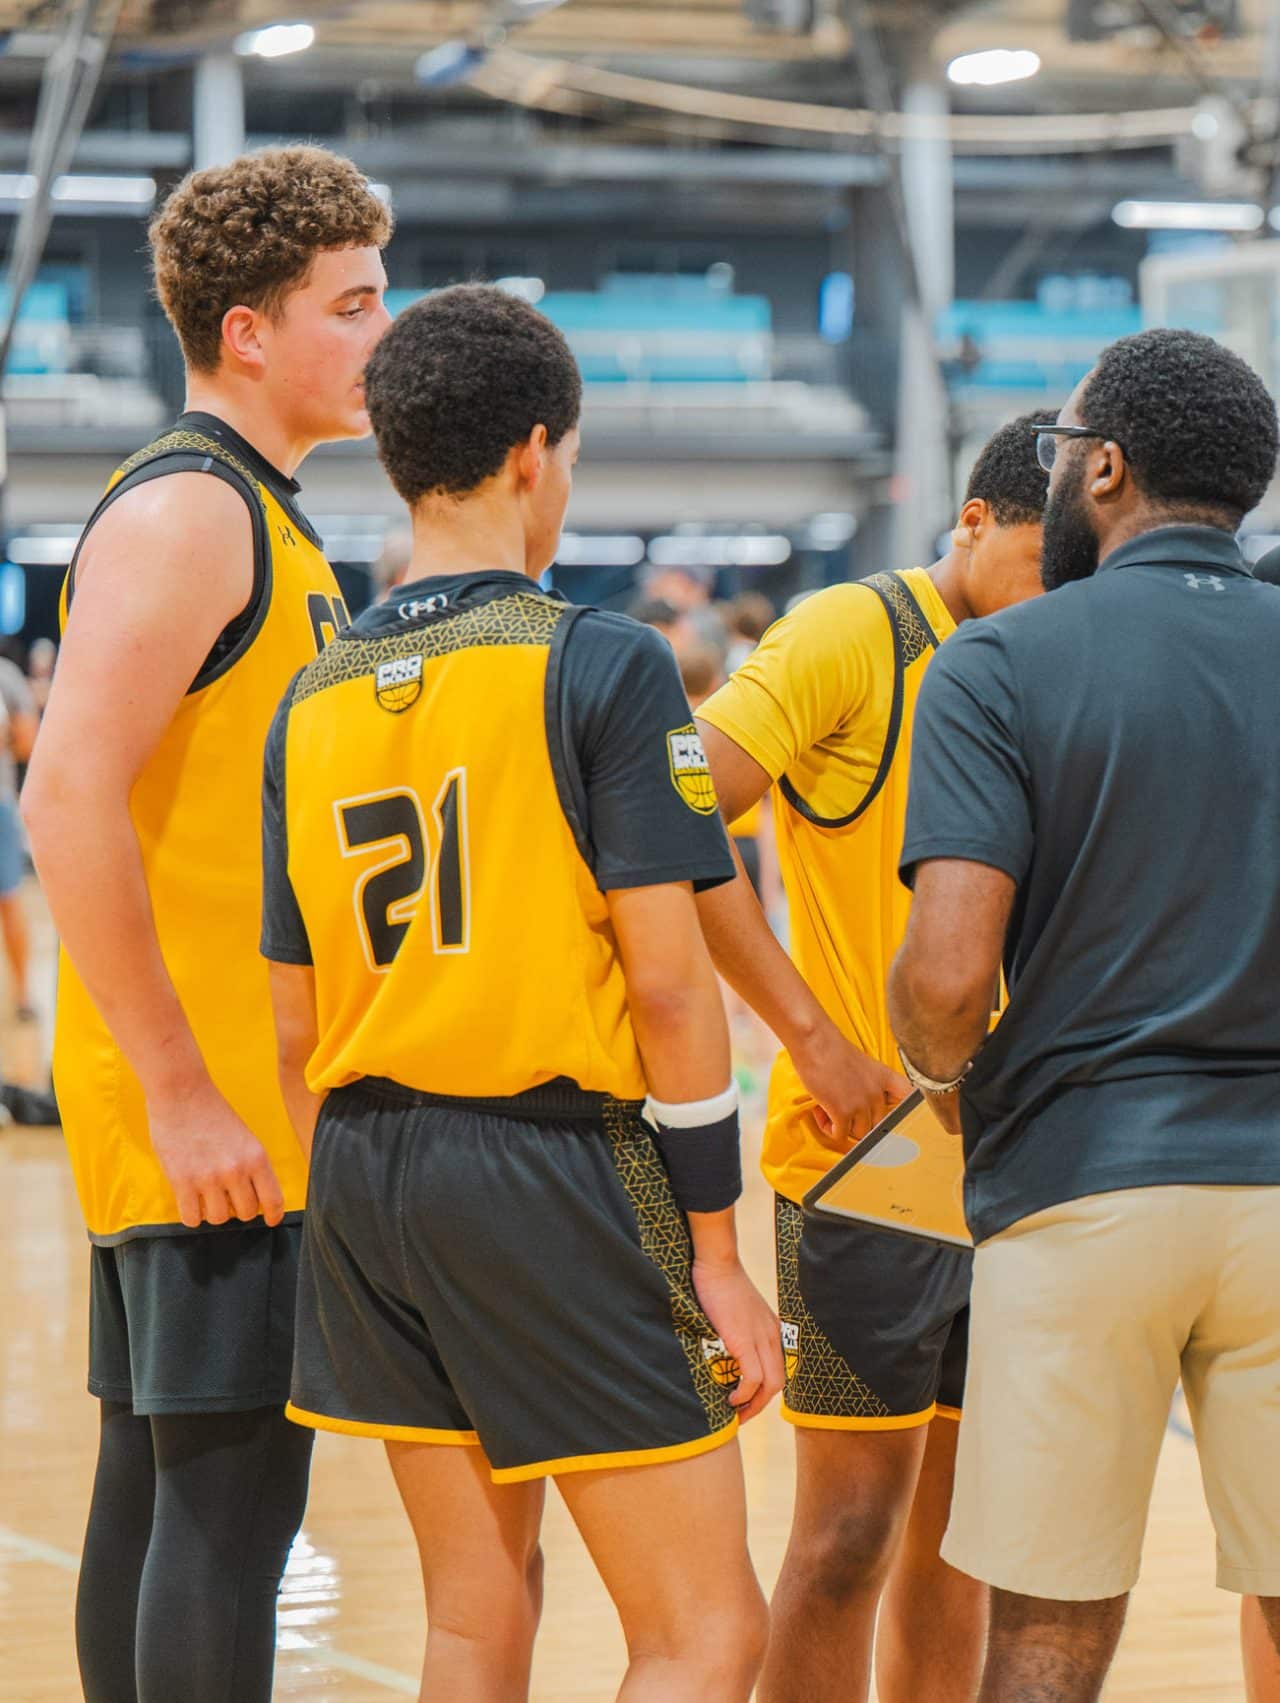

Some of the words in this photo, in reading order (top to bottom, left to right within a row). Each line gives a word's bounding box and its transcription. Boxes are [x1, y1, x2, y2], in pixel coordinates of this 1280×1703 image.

[377, 654, 423, 678] PRO
[670, 734, 705, 755] PR
[332, 766, 471, 974] 21
